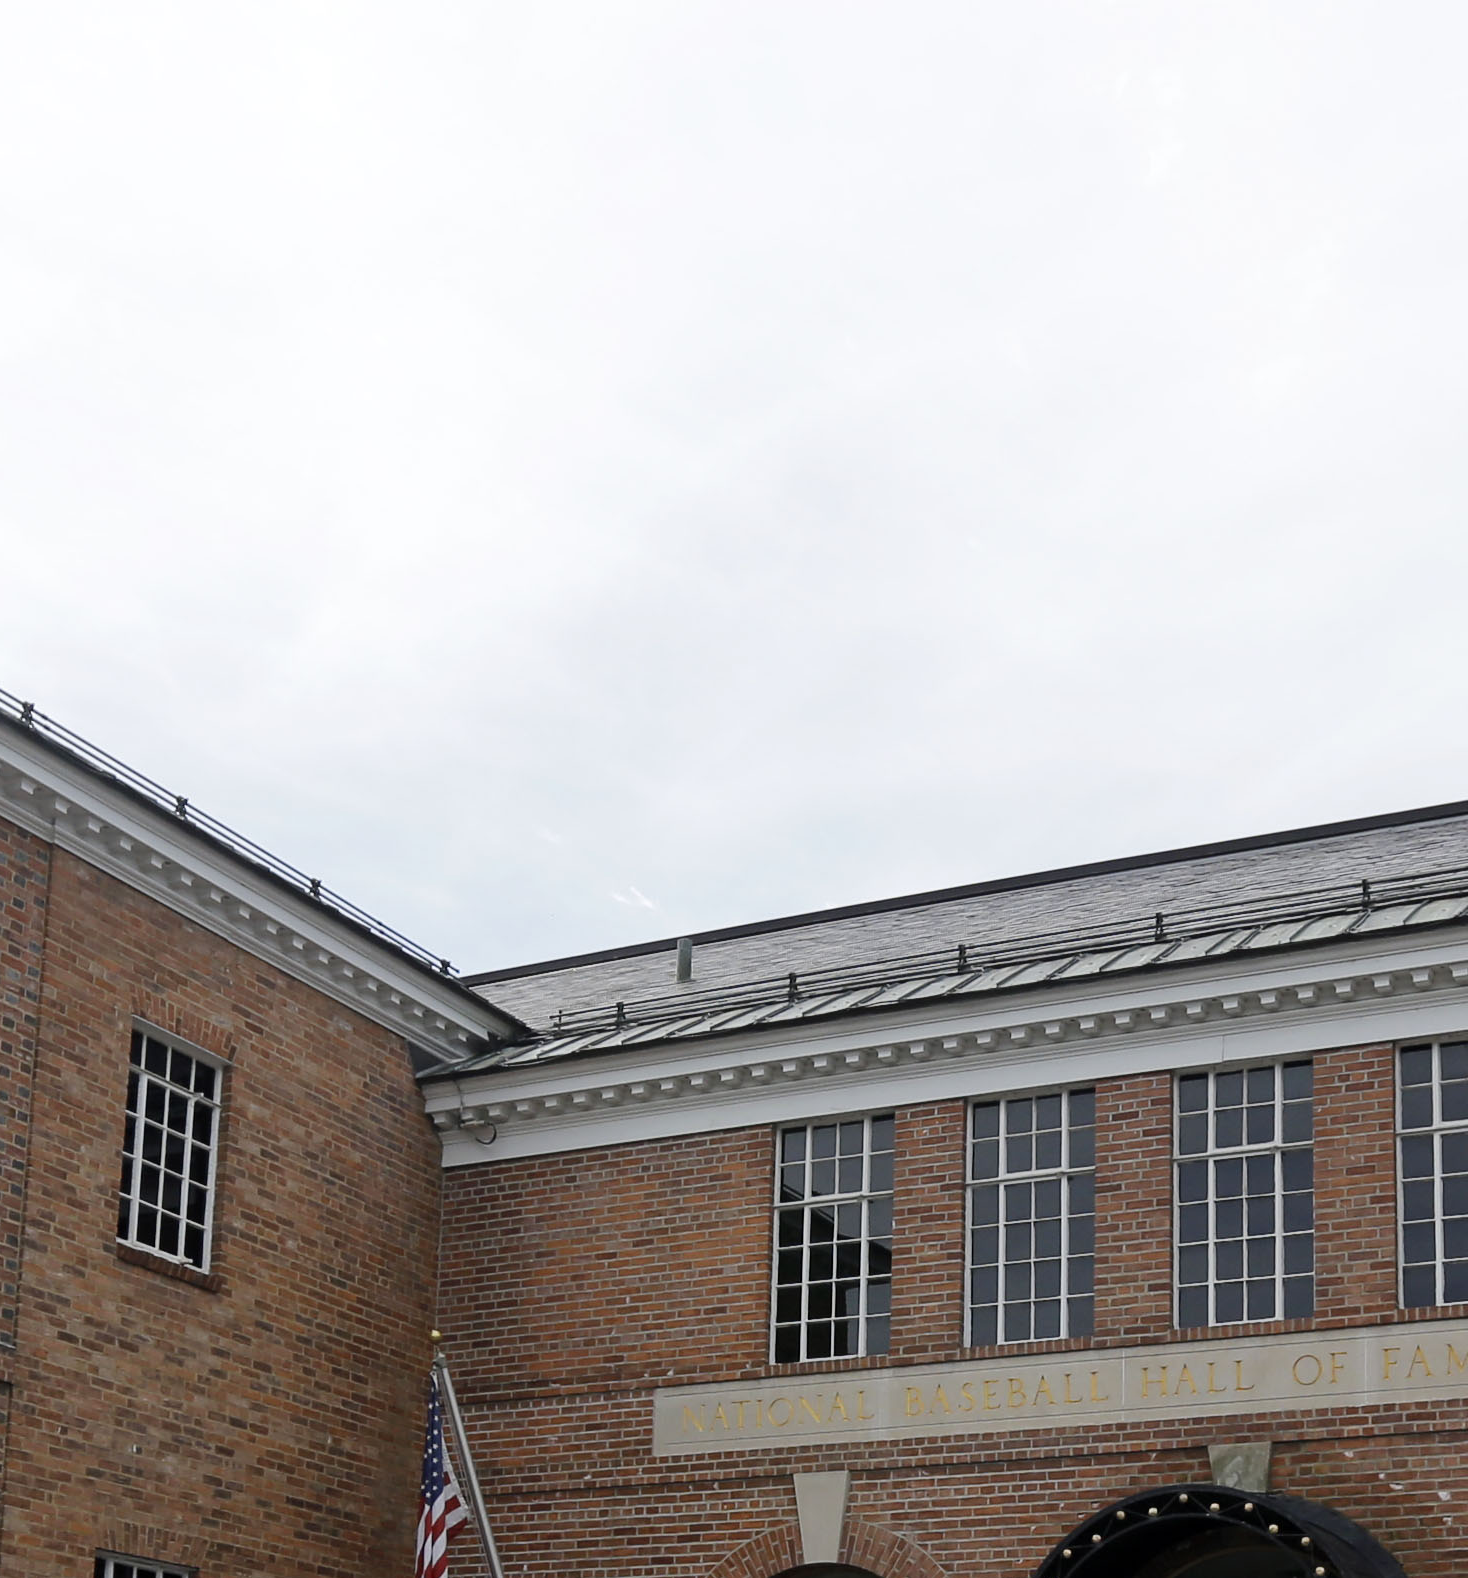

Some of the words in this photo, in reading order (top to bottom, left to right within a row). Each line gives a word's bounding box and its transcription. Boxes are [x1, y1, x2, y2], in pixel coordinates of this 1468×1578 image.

[683, 1390, 875, 1432] NATIONAL
[904, 1371, 1109, 1417] BASEBALL
[1141, 1360, 1255, 1398] HALL
[1292, 1351, 1348, 1386] OF
